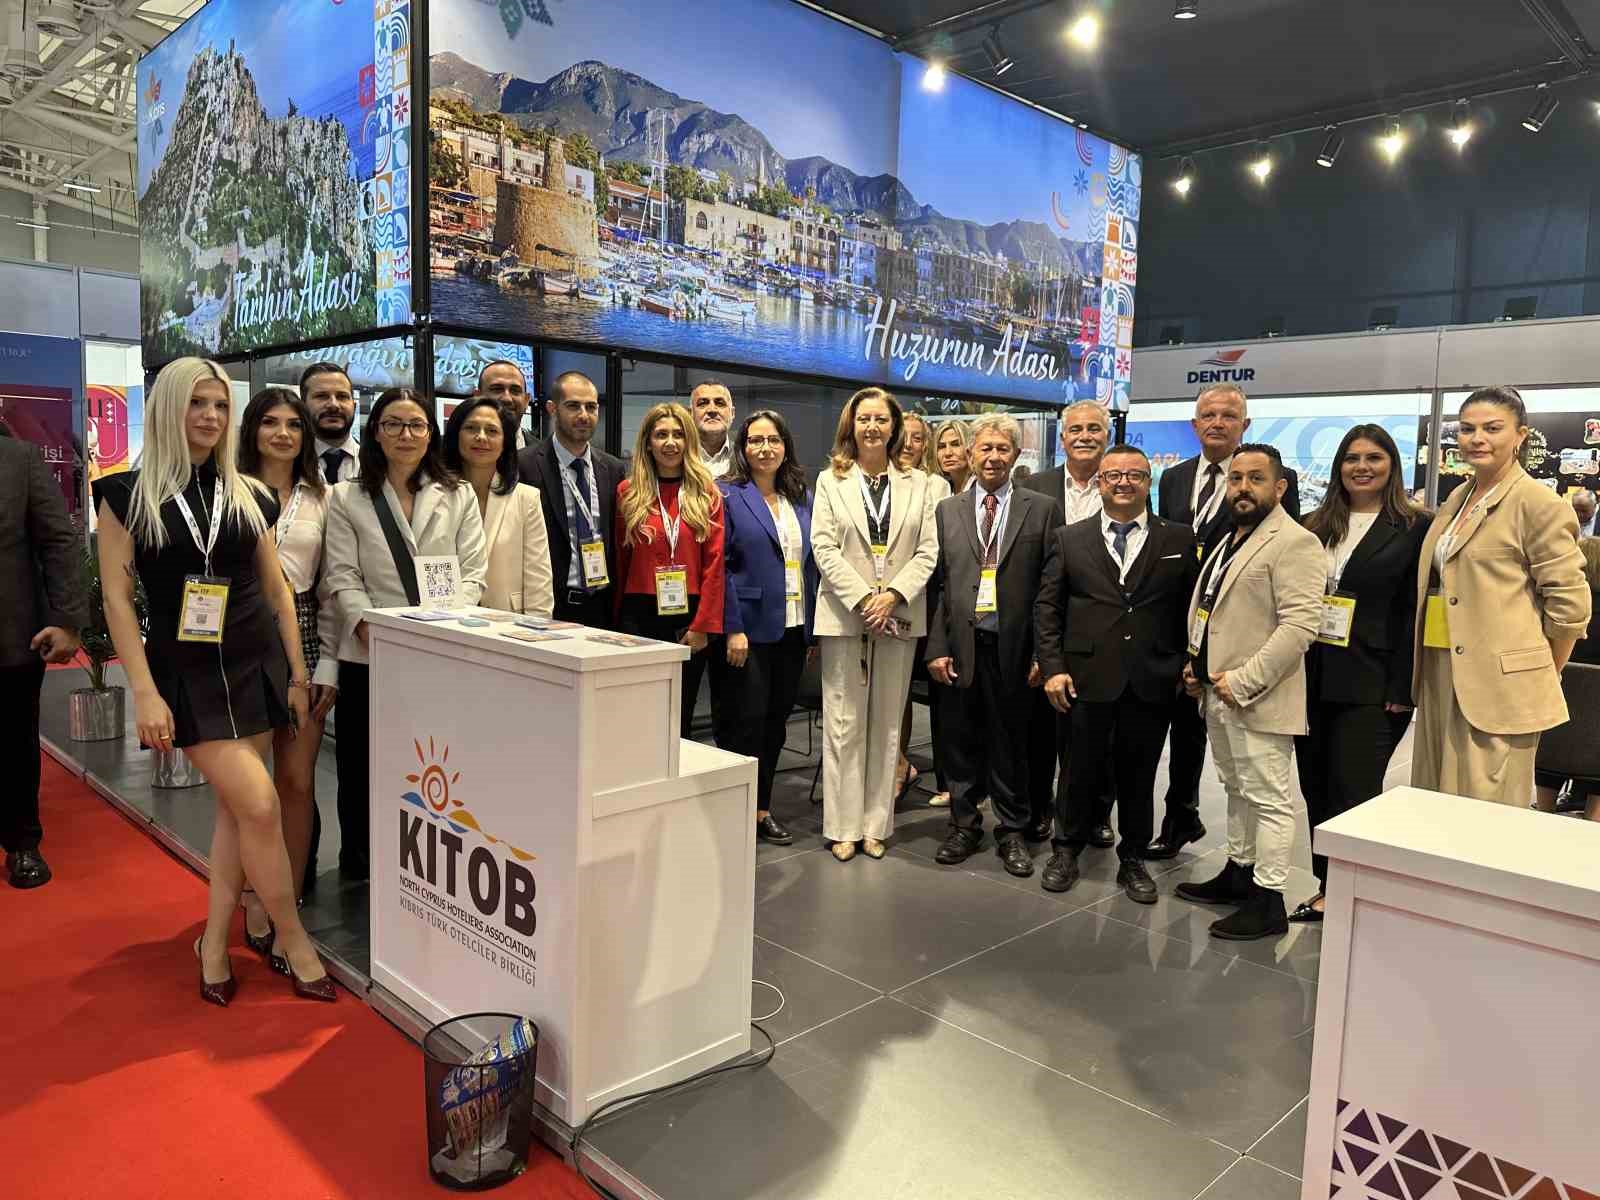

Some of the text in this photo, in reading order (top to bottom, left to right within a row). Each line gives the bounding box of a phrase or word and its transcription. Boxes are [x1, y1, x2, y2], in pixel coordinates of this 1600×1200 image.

[234, 250, 362, 332] Tarihin Adası
[289, 340, 408, 377] oprağın
[864, 297, 1058, 381] Huzurun Adası
[1187, 368, 1255, 383] DENTUR
[399, 808, 537, 936] KITOB
[399, 873, 536, 962] NORTH CYPRUS HOTELIERS ASSOCIATION
[399, 895, 424, 919] KIBRIS
[500, 955, 536, 987] BİRLİĞİ
